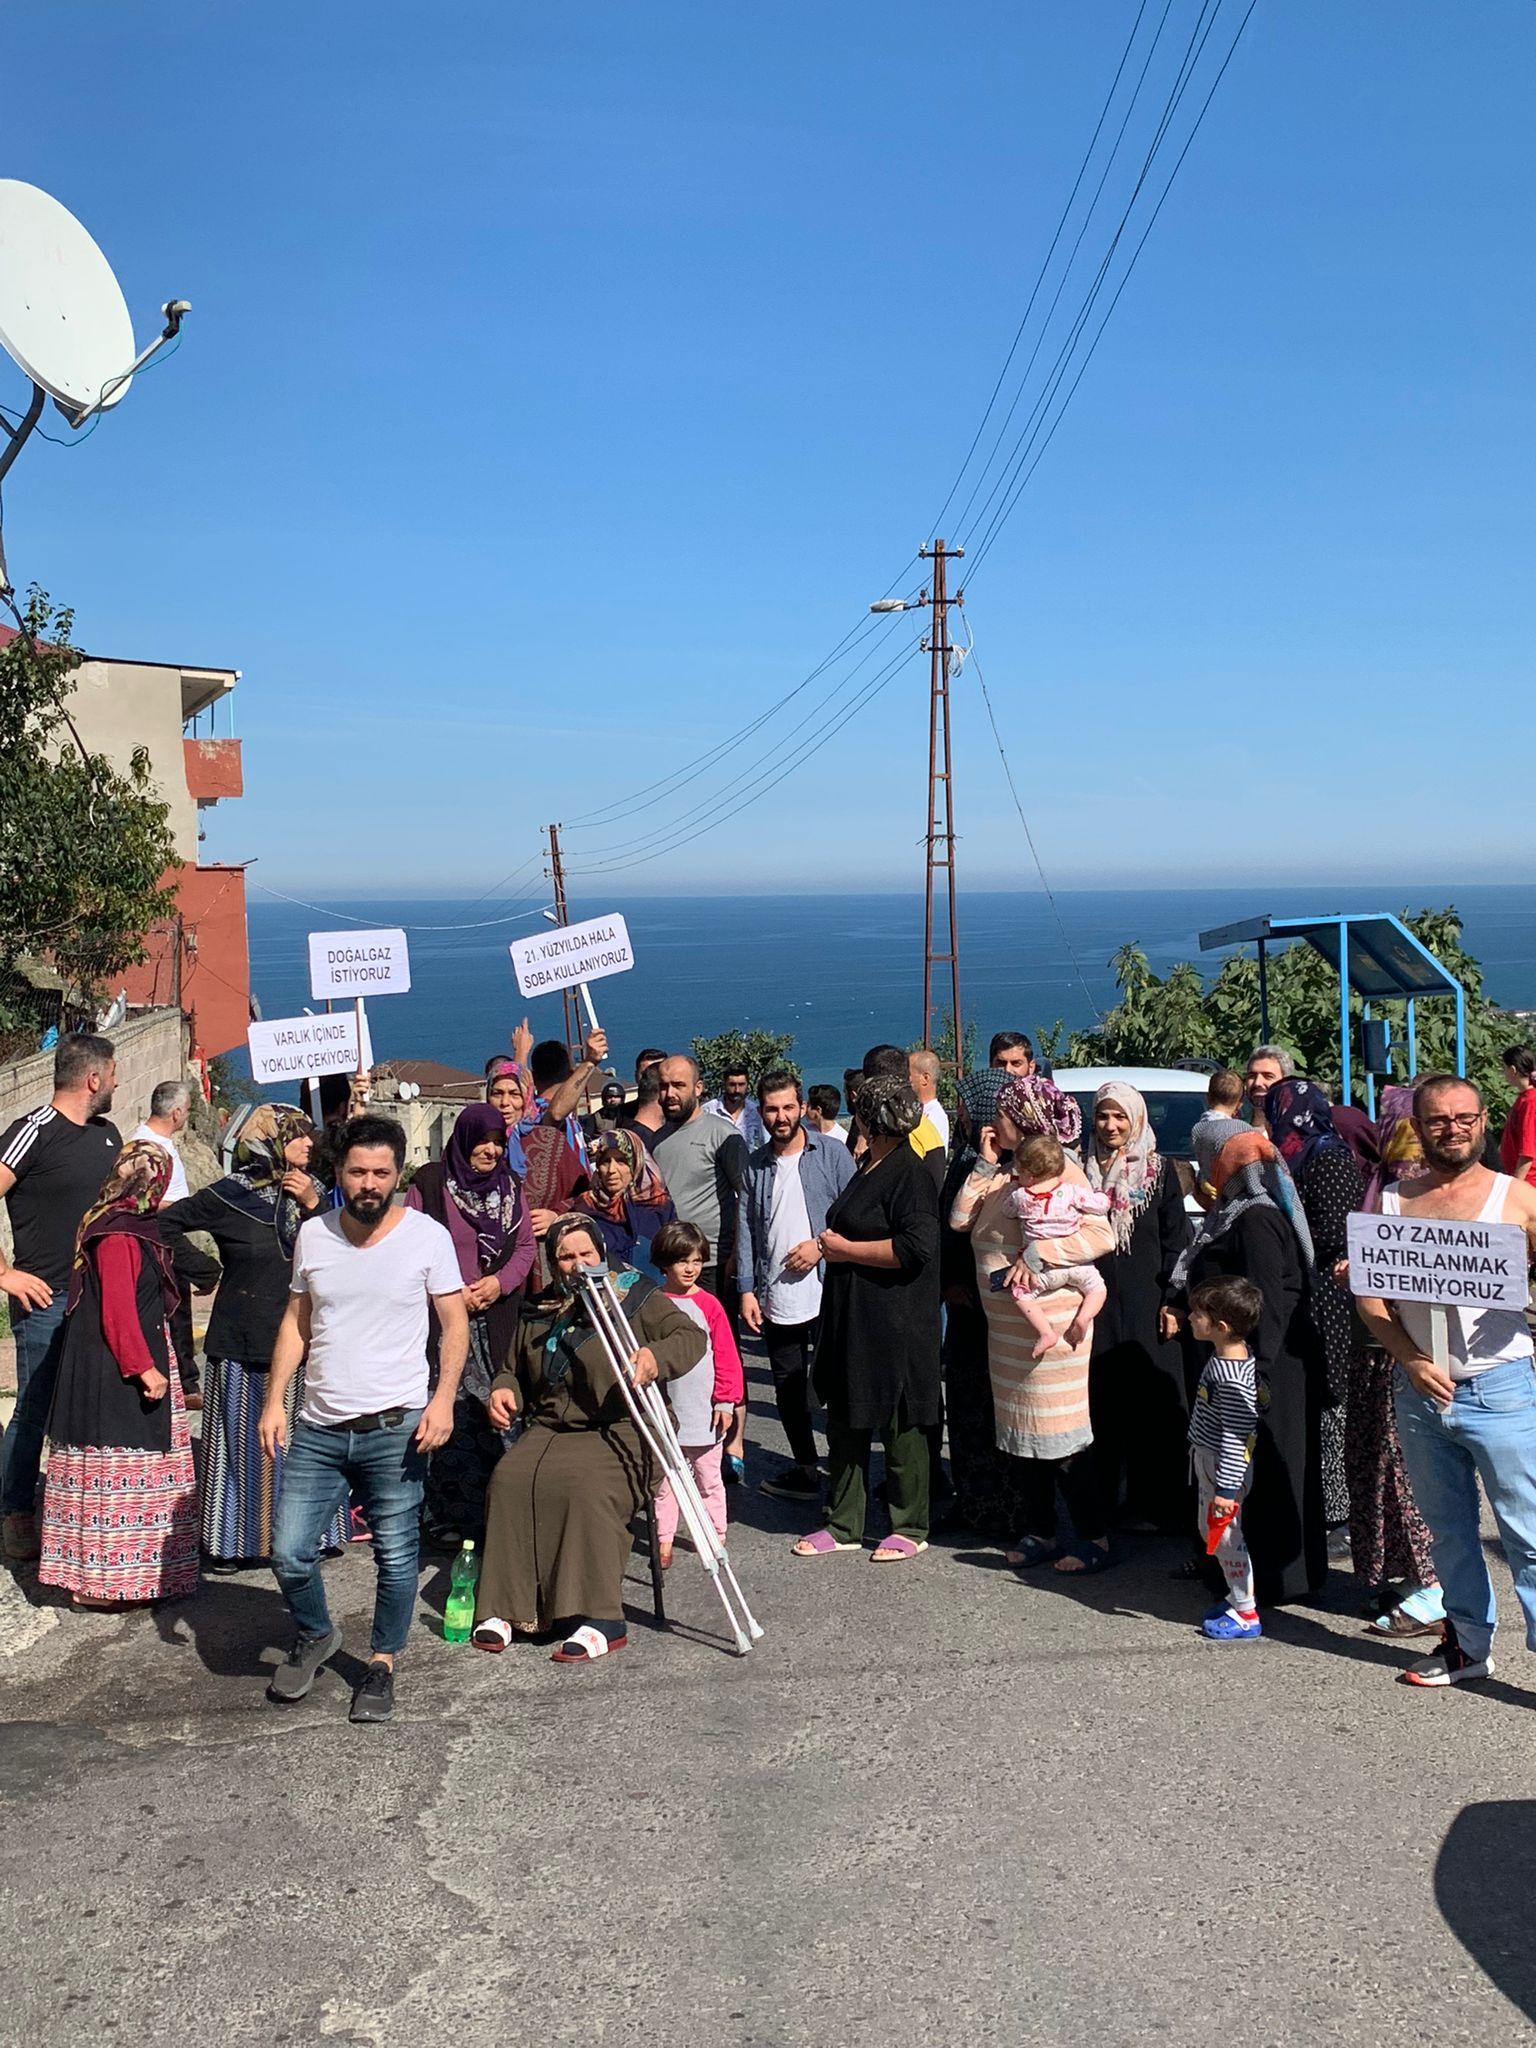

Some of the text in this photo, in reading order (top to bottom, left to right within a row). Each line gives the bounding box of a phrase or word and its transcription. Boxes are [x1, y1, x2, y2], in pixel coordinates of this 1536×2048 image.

[328, 947, 391, 964] DOĞALGAZ
[525, 927, 616, 964] 21. YÜZYILDA HALA
[331, 966, 391, 983] İSTİYORUZ
[524, 948, 628, 989] SOBA KULLANIYORUZ
[273, 1023, 346, 1046] VARLIK İÇİNDE
[261, 1048, 359, 1073] YOKLUK ÇEKİYORU
[1377, 1223, 1489, 1249] OY ZAMANI
[1361, 1247, 1509, 1276] HATIRLANMAK
[1367, 1268, 1505, 1301] İSTEMİYORUZ
